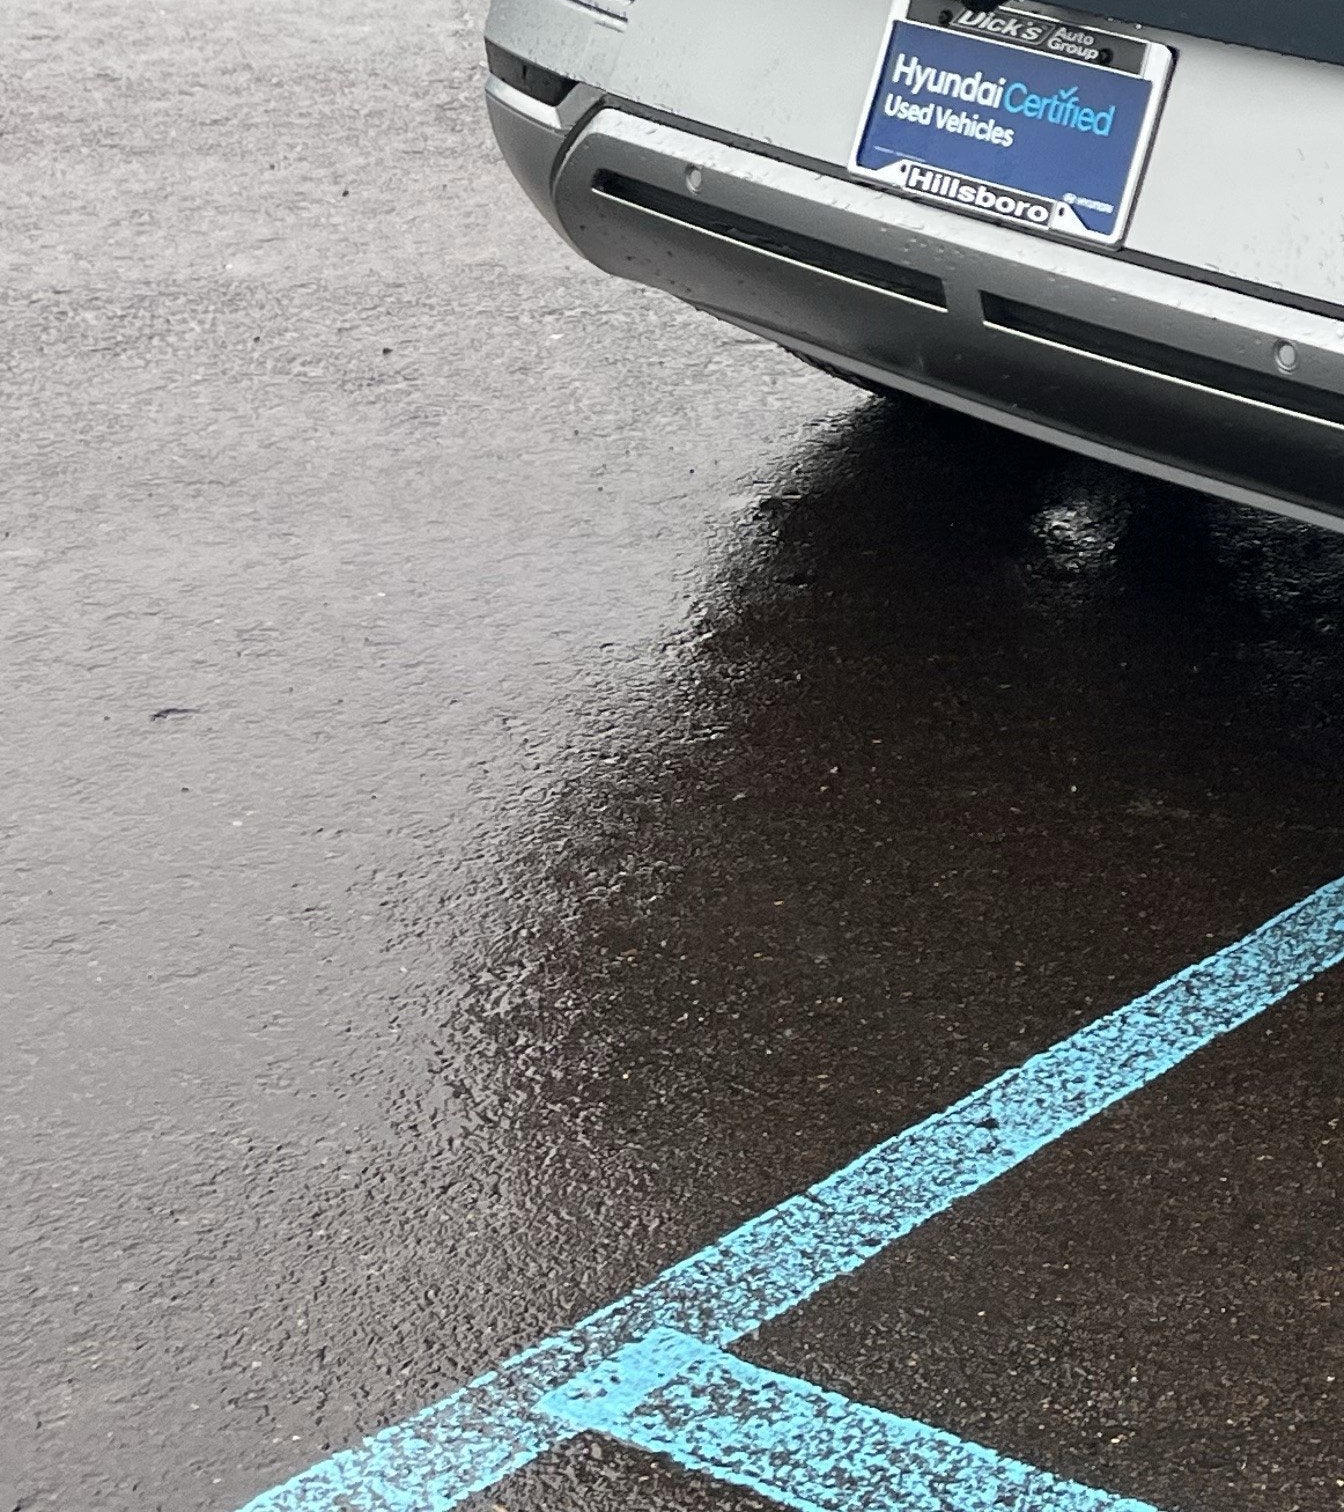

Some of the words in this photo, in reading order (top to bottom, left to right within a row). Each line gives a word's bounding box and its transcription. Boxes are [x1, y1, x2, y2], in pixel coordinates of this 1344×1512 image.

[957, 9, 1043, 42] Dick's
[1054, 26, 1096, 46] Auto
[1047, 37, 1100, 61] Group
[891, 52, 1007, 109] Hyundai
[1003, 81, 1117, 137] Certified
[884, 94, 934, 126] Used
[935, 104, 1016, 148] Vehicles
[908, 166, 1050, 222] Hillsboro
